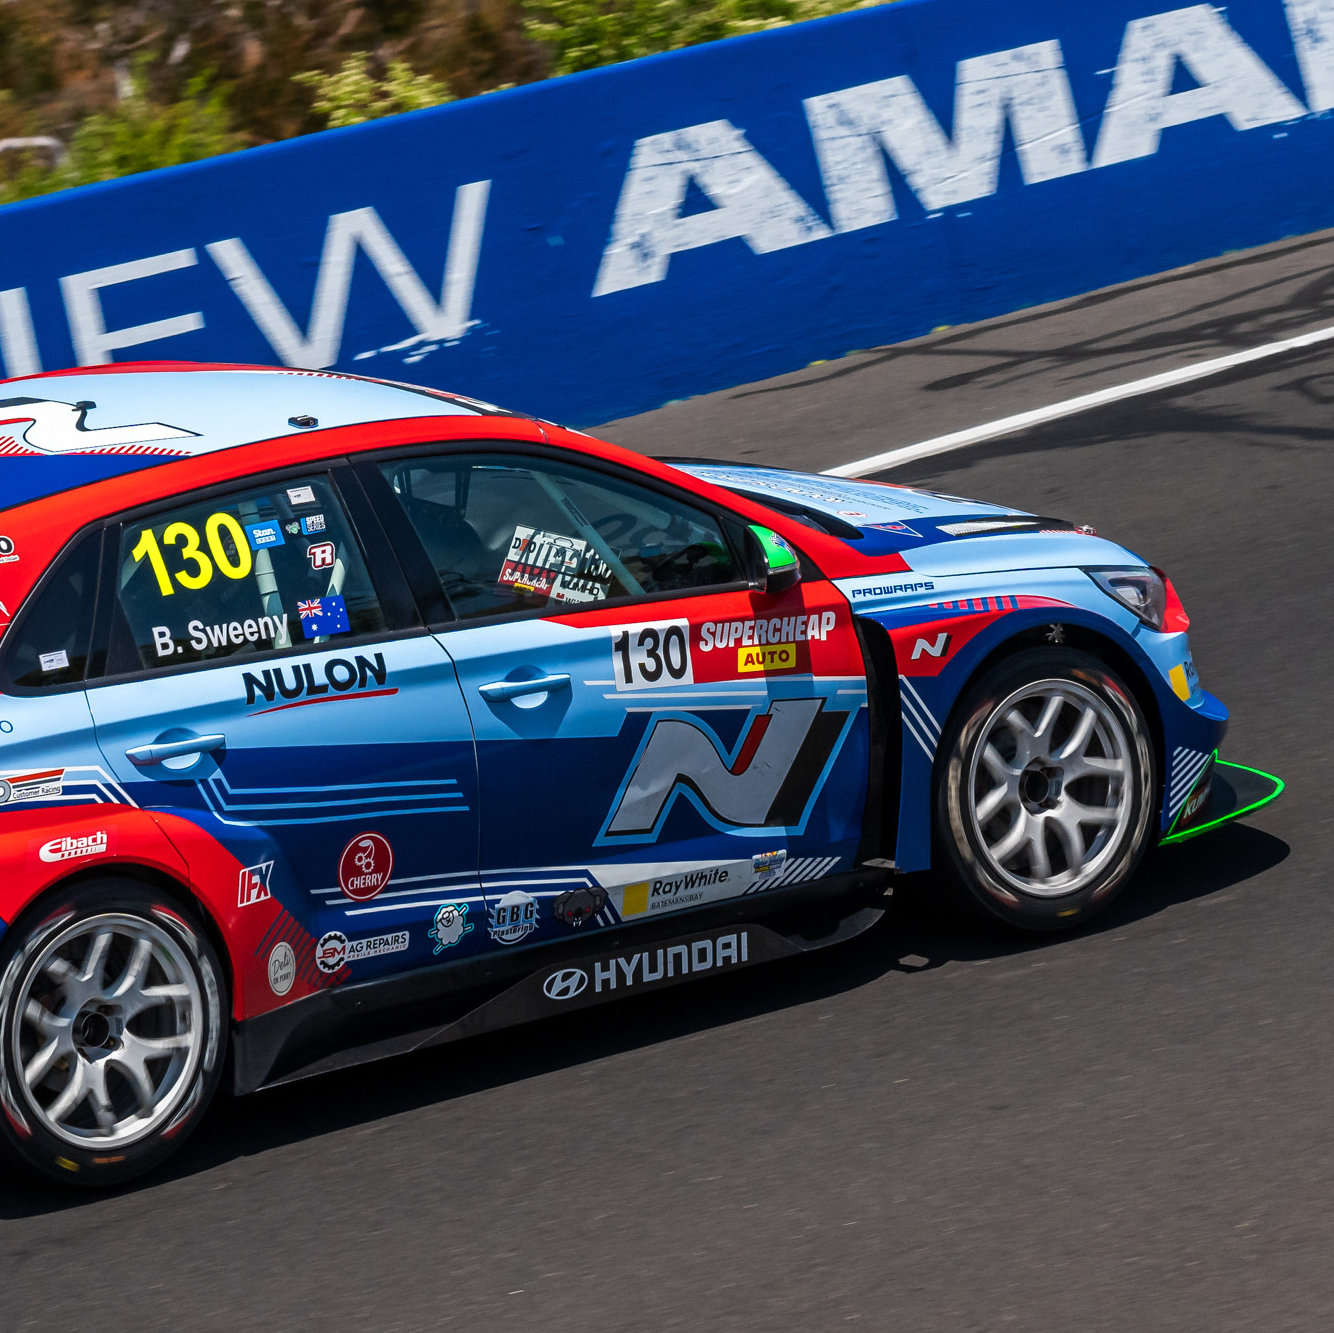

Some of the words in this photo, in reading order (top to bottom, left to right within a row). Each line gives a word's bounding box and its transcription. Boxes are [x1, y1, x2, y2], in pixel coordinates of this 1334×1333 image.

[132, 512, 252, 596] 130
[852, 582, 934, 598] PROWRAPS
[152, 626, 183, 657] B.
[190, 613, 288, 651] Sweeny
[700, 611, 836, 652] SUPERCHEAP
[615, 625, 688, 684] 130
[744, 647, 791, 666] AUTO
[243, 653, 386, 705] NULON
[12, 789, 40, 800] Customer
[41, 785, 61, 798] Racing
[39, 832, 107, 863] Eibach
[348, 872, 383, 890] CHERRY
[496, 902, 535, 926] GBG
[492, 923, 534, 938] Plastering
[317, 944, 346, 960] JSM
[348, 941, 365, 955] AG
[365, 933, 407, 950] REPAIRS
[347, 950, 371, 960] MOBILE
[373, 944, 407, 956] MECHANIC
[595, 931, 748, 992] HYUNDAI
